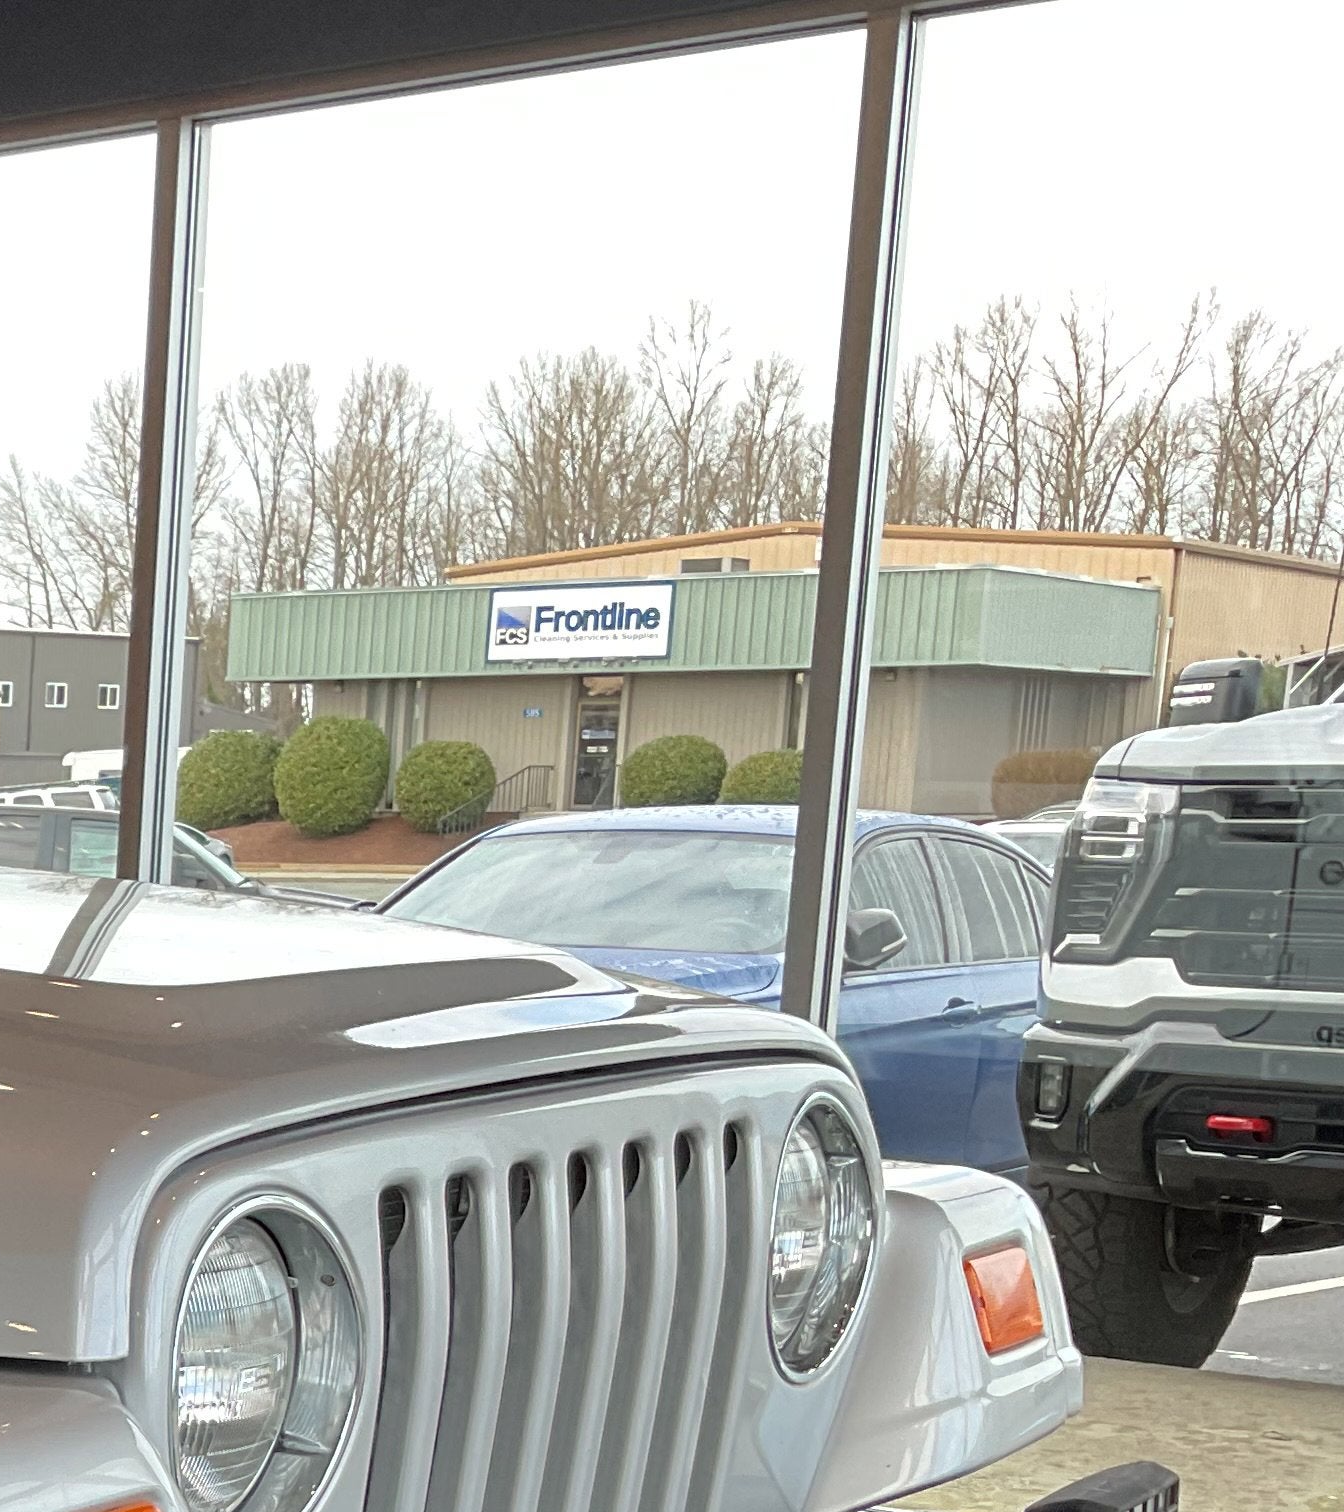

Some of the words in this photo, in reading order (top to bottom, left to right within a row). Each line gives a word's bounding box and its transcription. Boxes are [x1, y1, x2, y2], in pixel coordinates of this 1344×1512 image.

[534, 602, 661, 633] Frontline
[496, 627, 528, 645] FCS
[534, 634, 571, 643] Cleaning
[573, 633, 610, 642] Services
